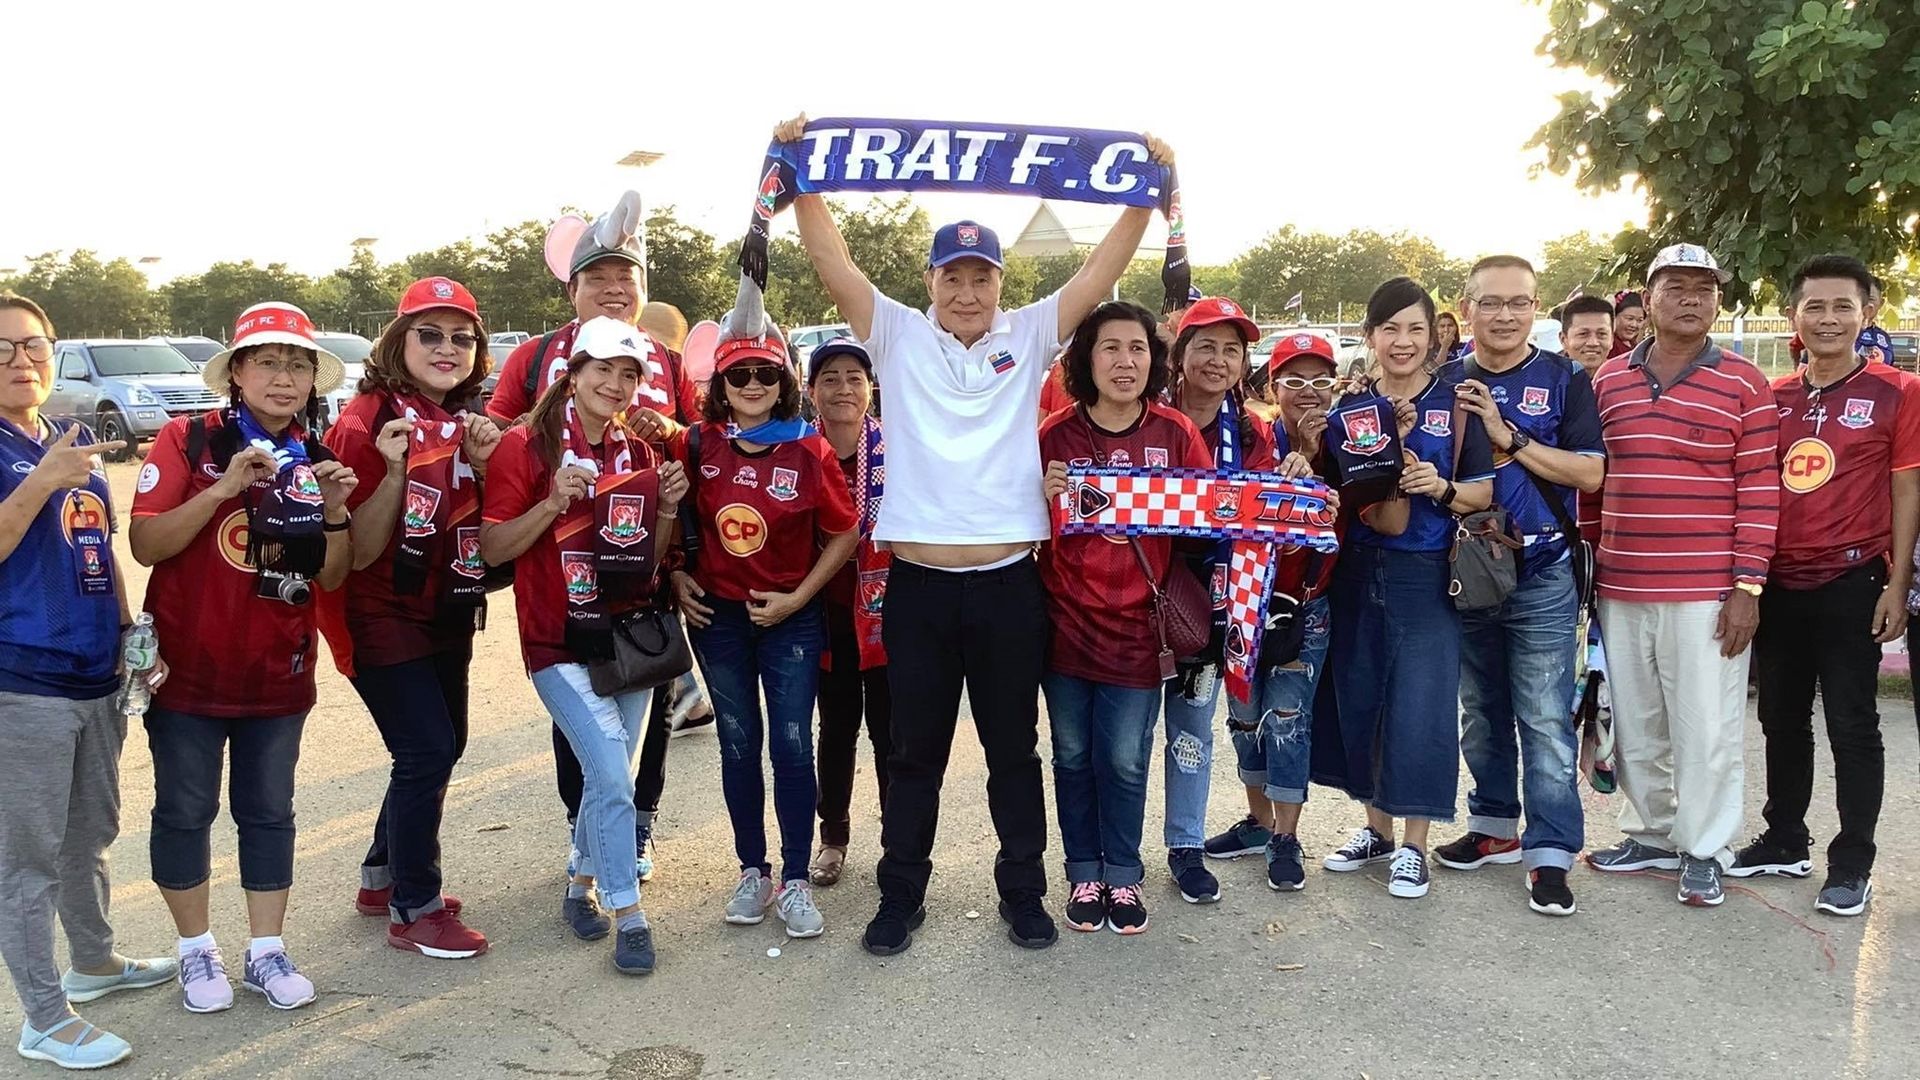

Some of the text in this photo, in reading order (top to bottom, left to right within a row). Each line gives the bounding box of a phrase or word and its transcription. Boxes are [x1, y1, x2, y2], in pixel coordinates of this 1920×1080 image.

[803, 127, 1008, 183] TRAT
[260, 315, 275, 326] FC
[1788, 454, 1826, 477] CP
[732, 475, 759, 489] Chang
[1068, 497, 1076, 522] SPORT
[78, 535, 102, 545] MEDIA
[721, 518, 760, 541] CP
